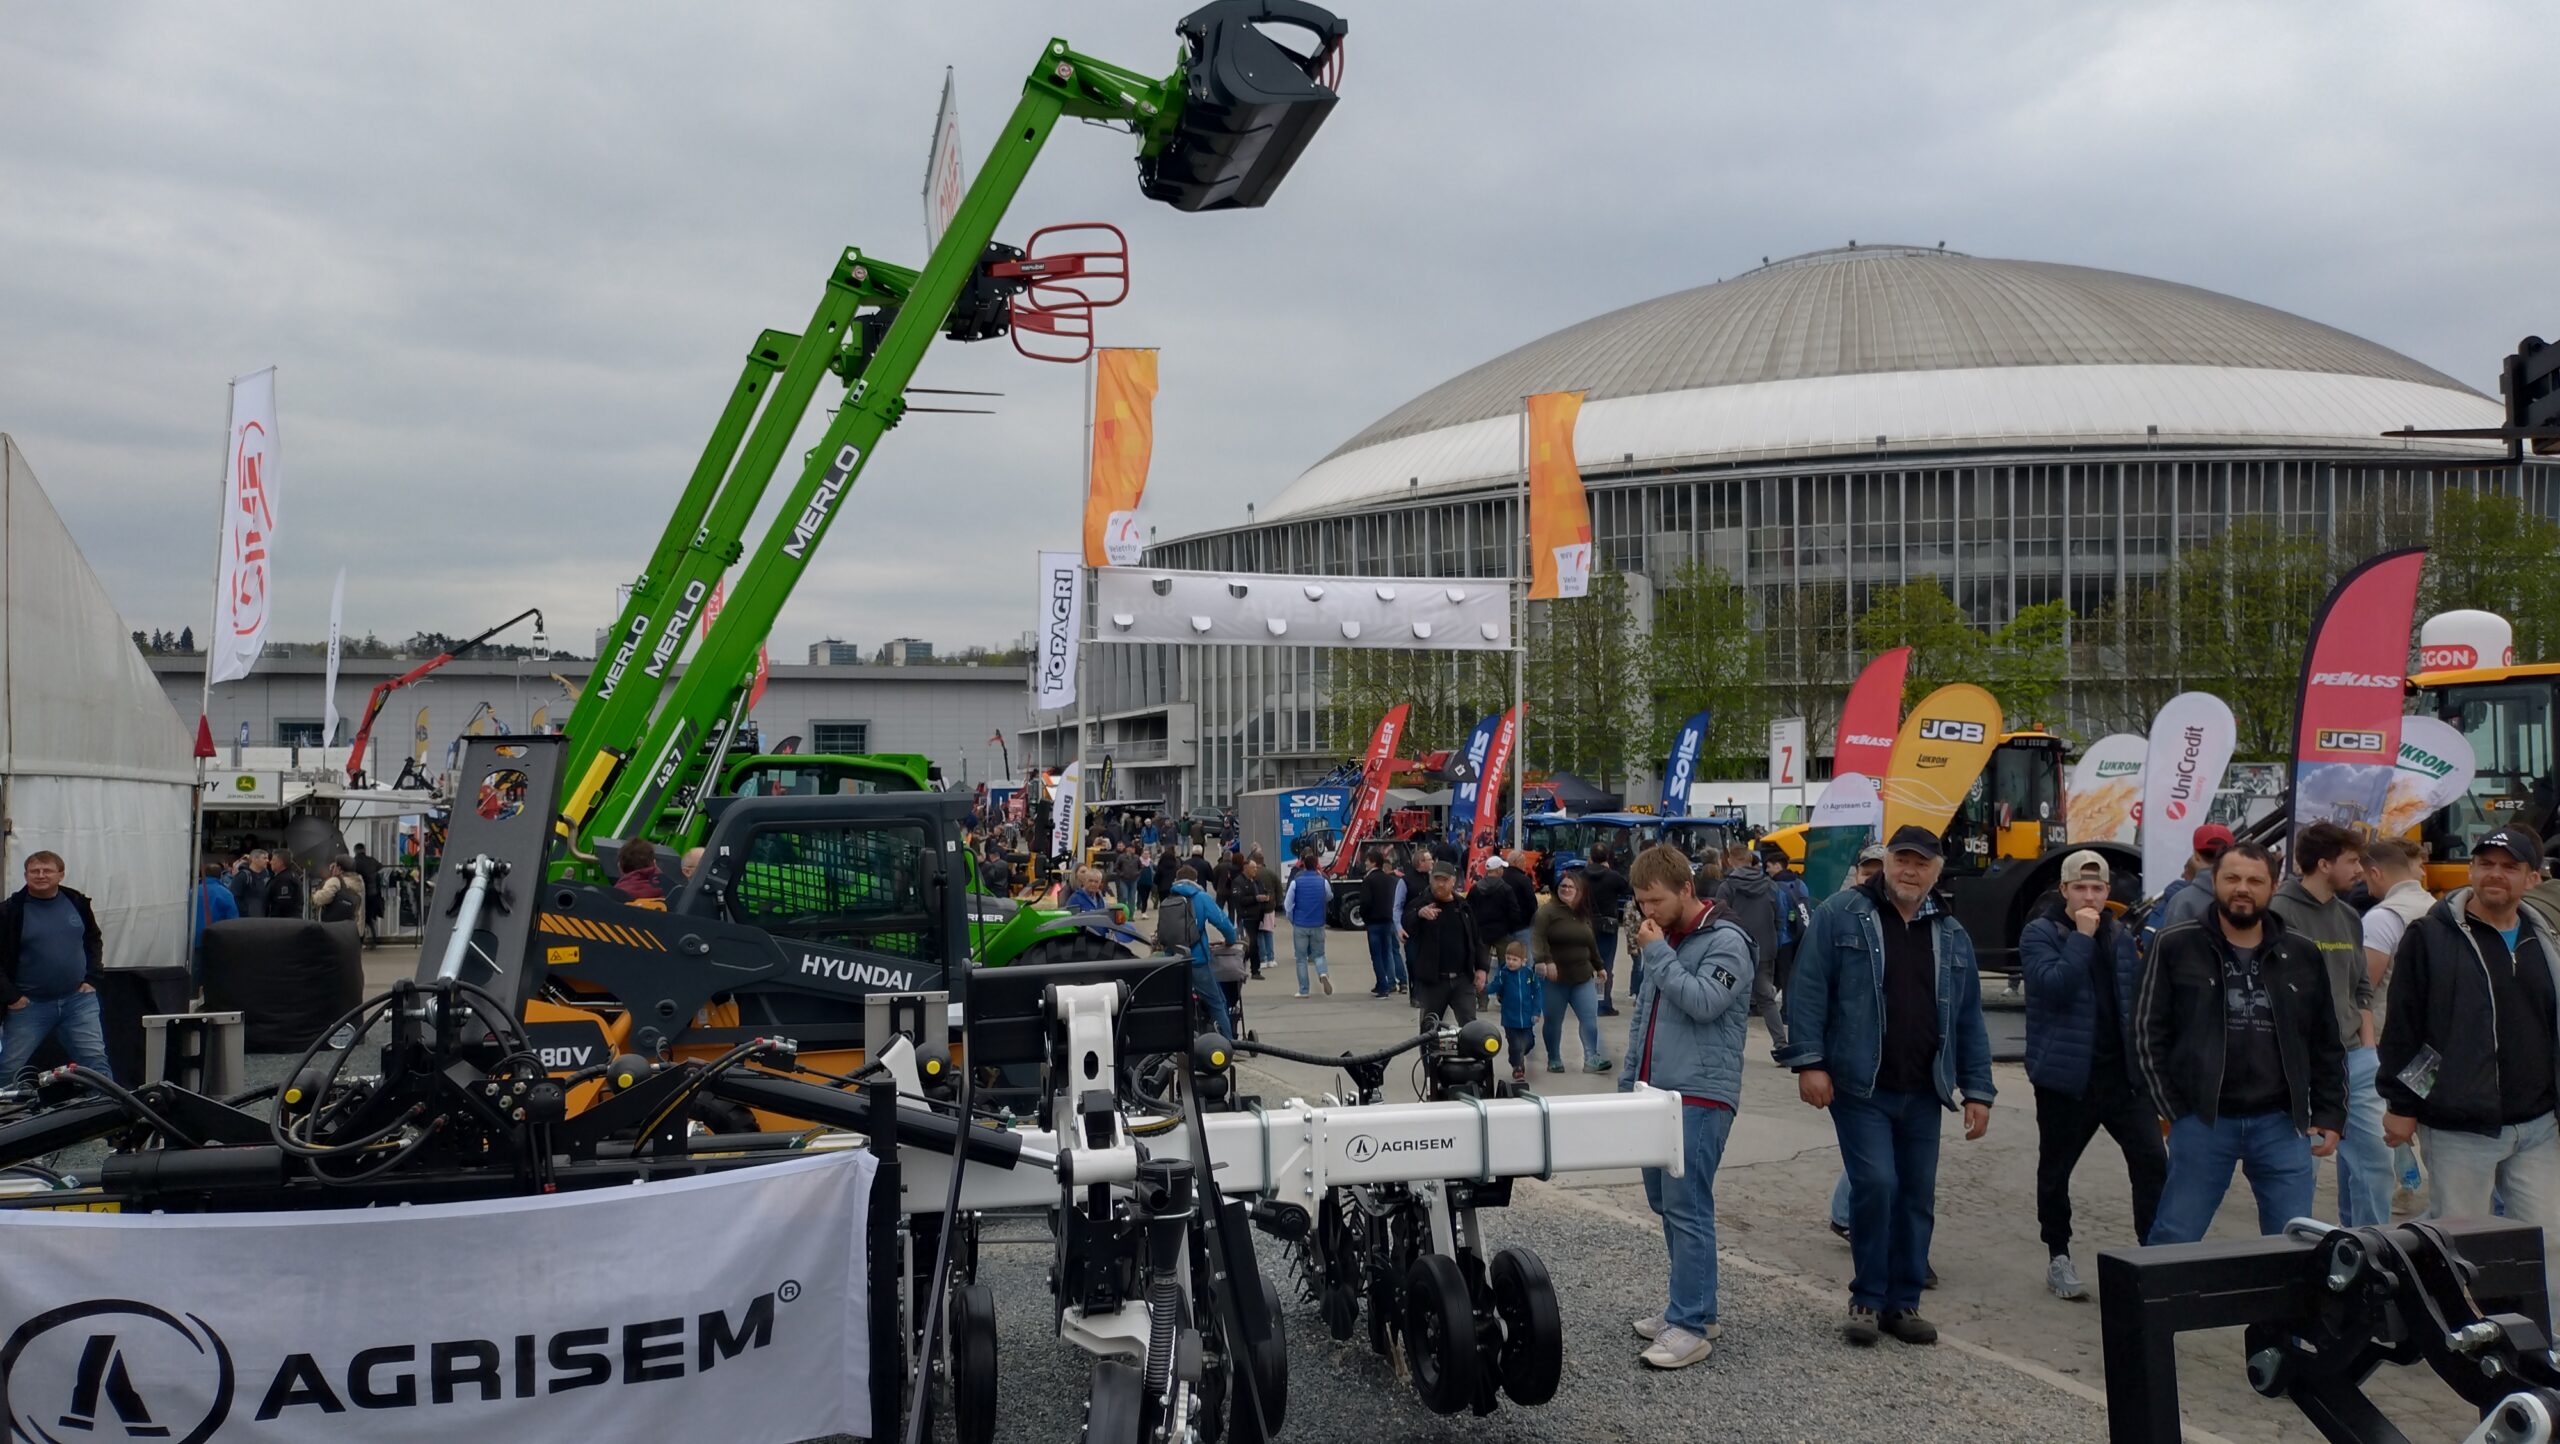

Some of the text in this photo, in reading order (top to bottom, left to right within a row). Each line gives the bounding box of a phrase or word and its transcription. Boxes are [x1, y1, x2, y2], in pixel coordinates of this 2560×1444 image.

[783, 444, 861, 560] MERLO
[644, 579, 707, 678] MERLO
[1043, 569, 1073, 694] TOPAGRI
[597, 615, 650, 700] MERLO
[1921, 721, 1983, 742] JCB
[2320, 732, 2382, 750] JCB
[656, 748, 683, 789] 42.7
[1780, 746, 1793, 784] Z
[2098, 759, 2142, 771] LUKROM
[2170, 724, 2204, 800] UniCredit
[1830, 802, 1860, 810] Agroteam
[1964, 839, 1989, 854] JCB
[2049, 826, 2066, 843] JCB
[801, 954, 912, 992] HYUNDAI
[528, 1046, 593, 1067] 80V
